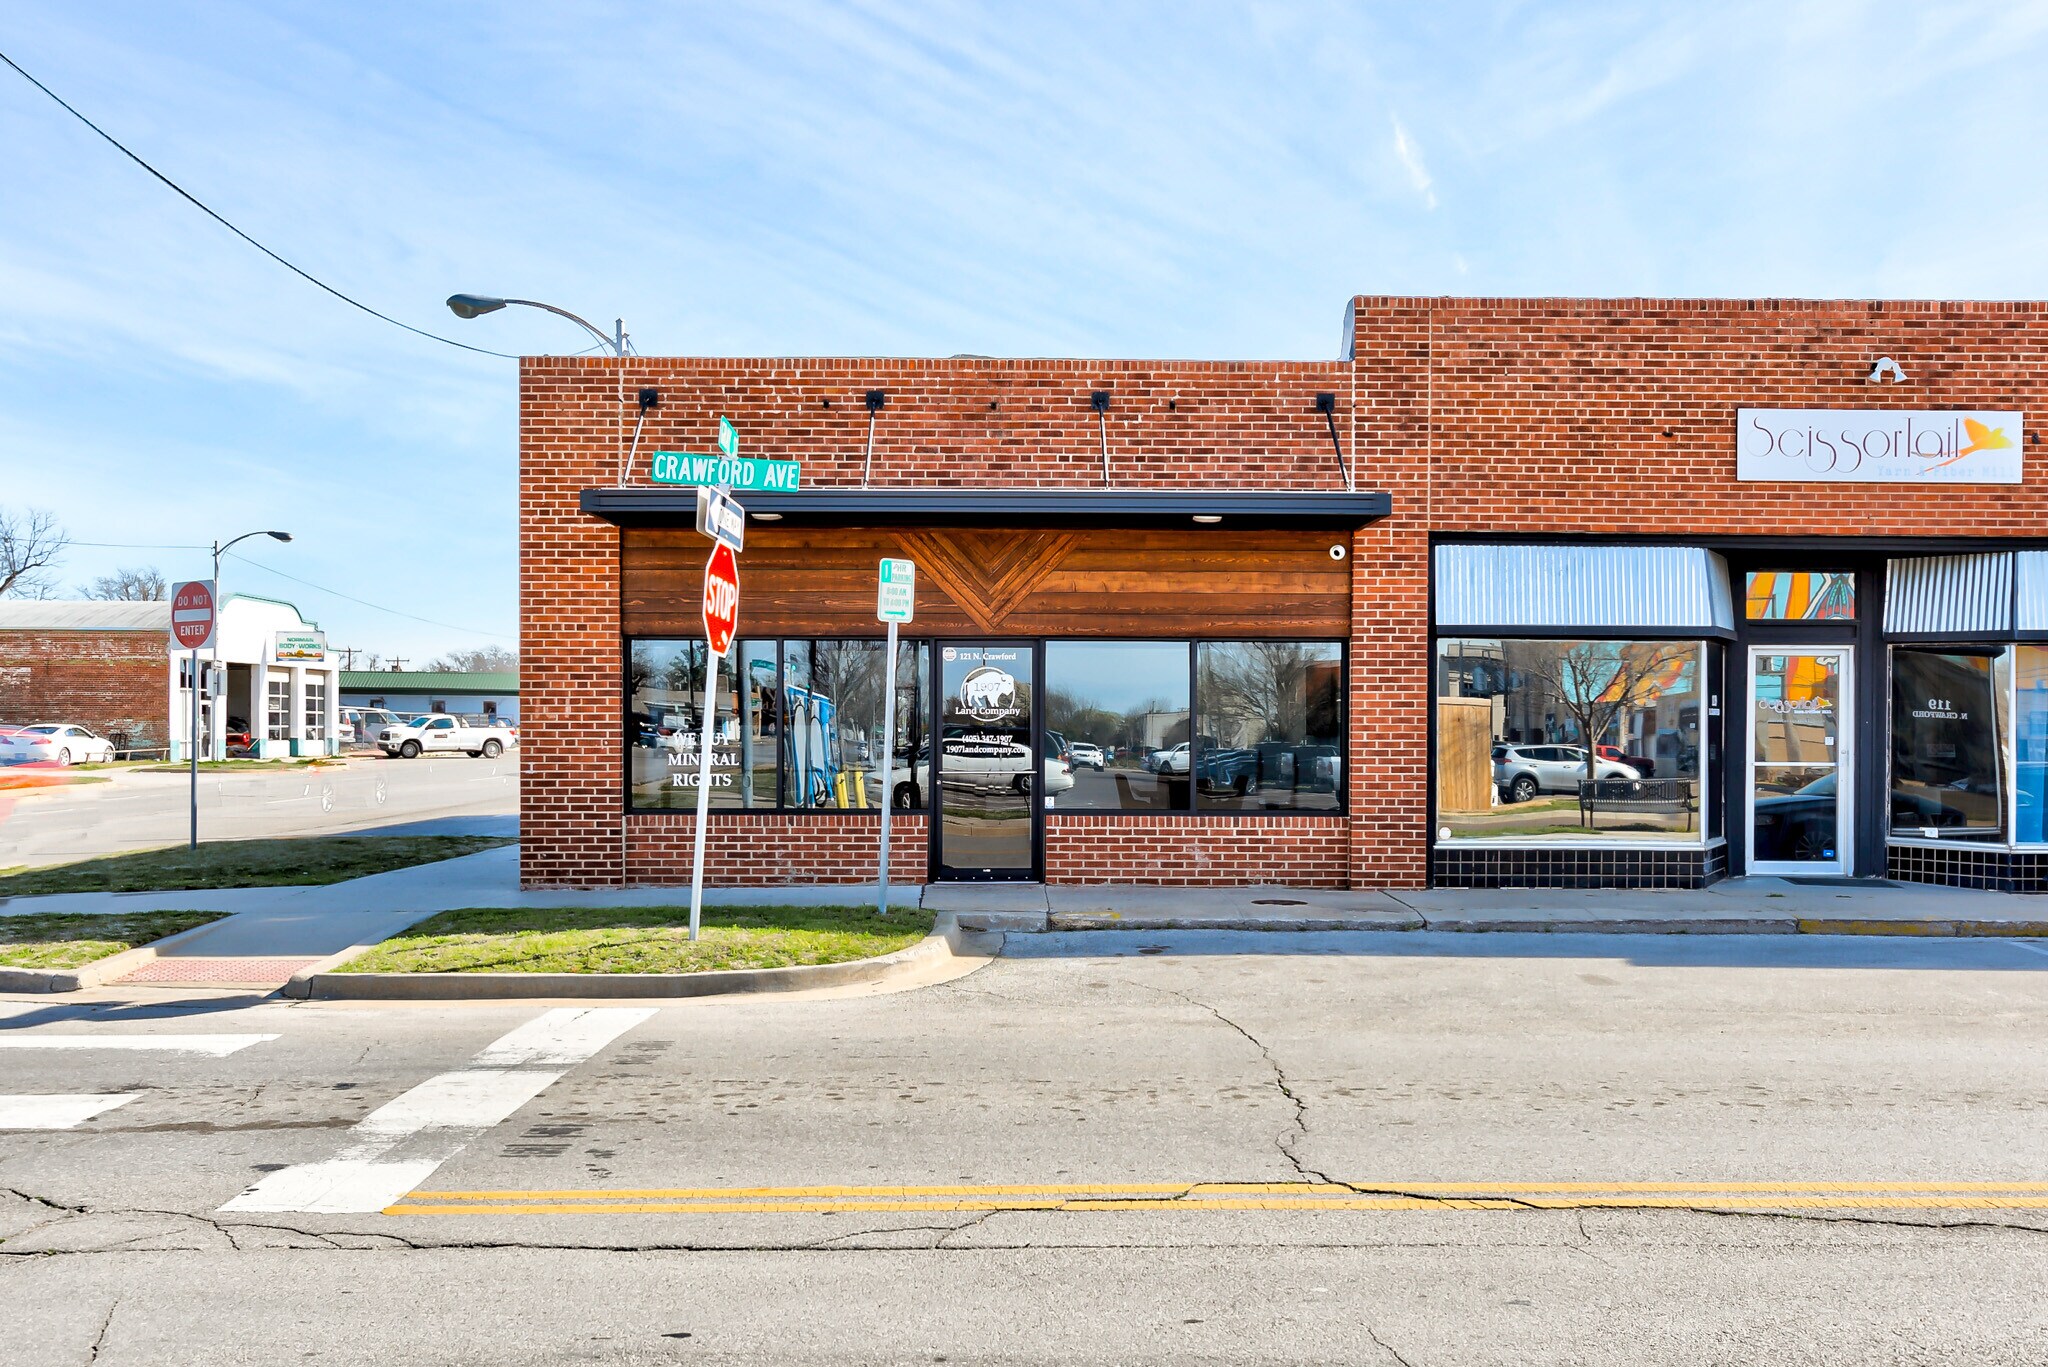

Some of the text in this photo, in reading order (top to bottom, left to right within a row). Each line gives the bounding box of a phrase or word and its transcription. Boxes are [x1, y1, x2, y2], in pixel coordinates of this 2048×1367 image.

[654, 454, 798, 489] CRAWFORD AVE
[1876, 465, 1911, 477] Yarn
[1982, 466, 2015, 478] Mill
[177, 594, 208, 607] DO NOT
[706, 574, 736, 623] STOP
[180, 624, 205, 636] ENTER
[983, 652, 1017, 660] Crawford
[974, 682, 1001, 692] 1907
[955, 707, 1021, 718] Land Company
[673, 732, 729, 746] WE UY
[981, 735, 1013, 743] 347-1907
[667, 753, 740, 766] MINRAL
